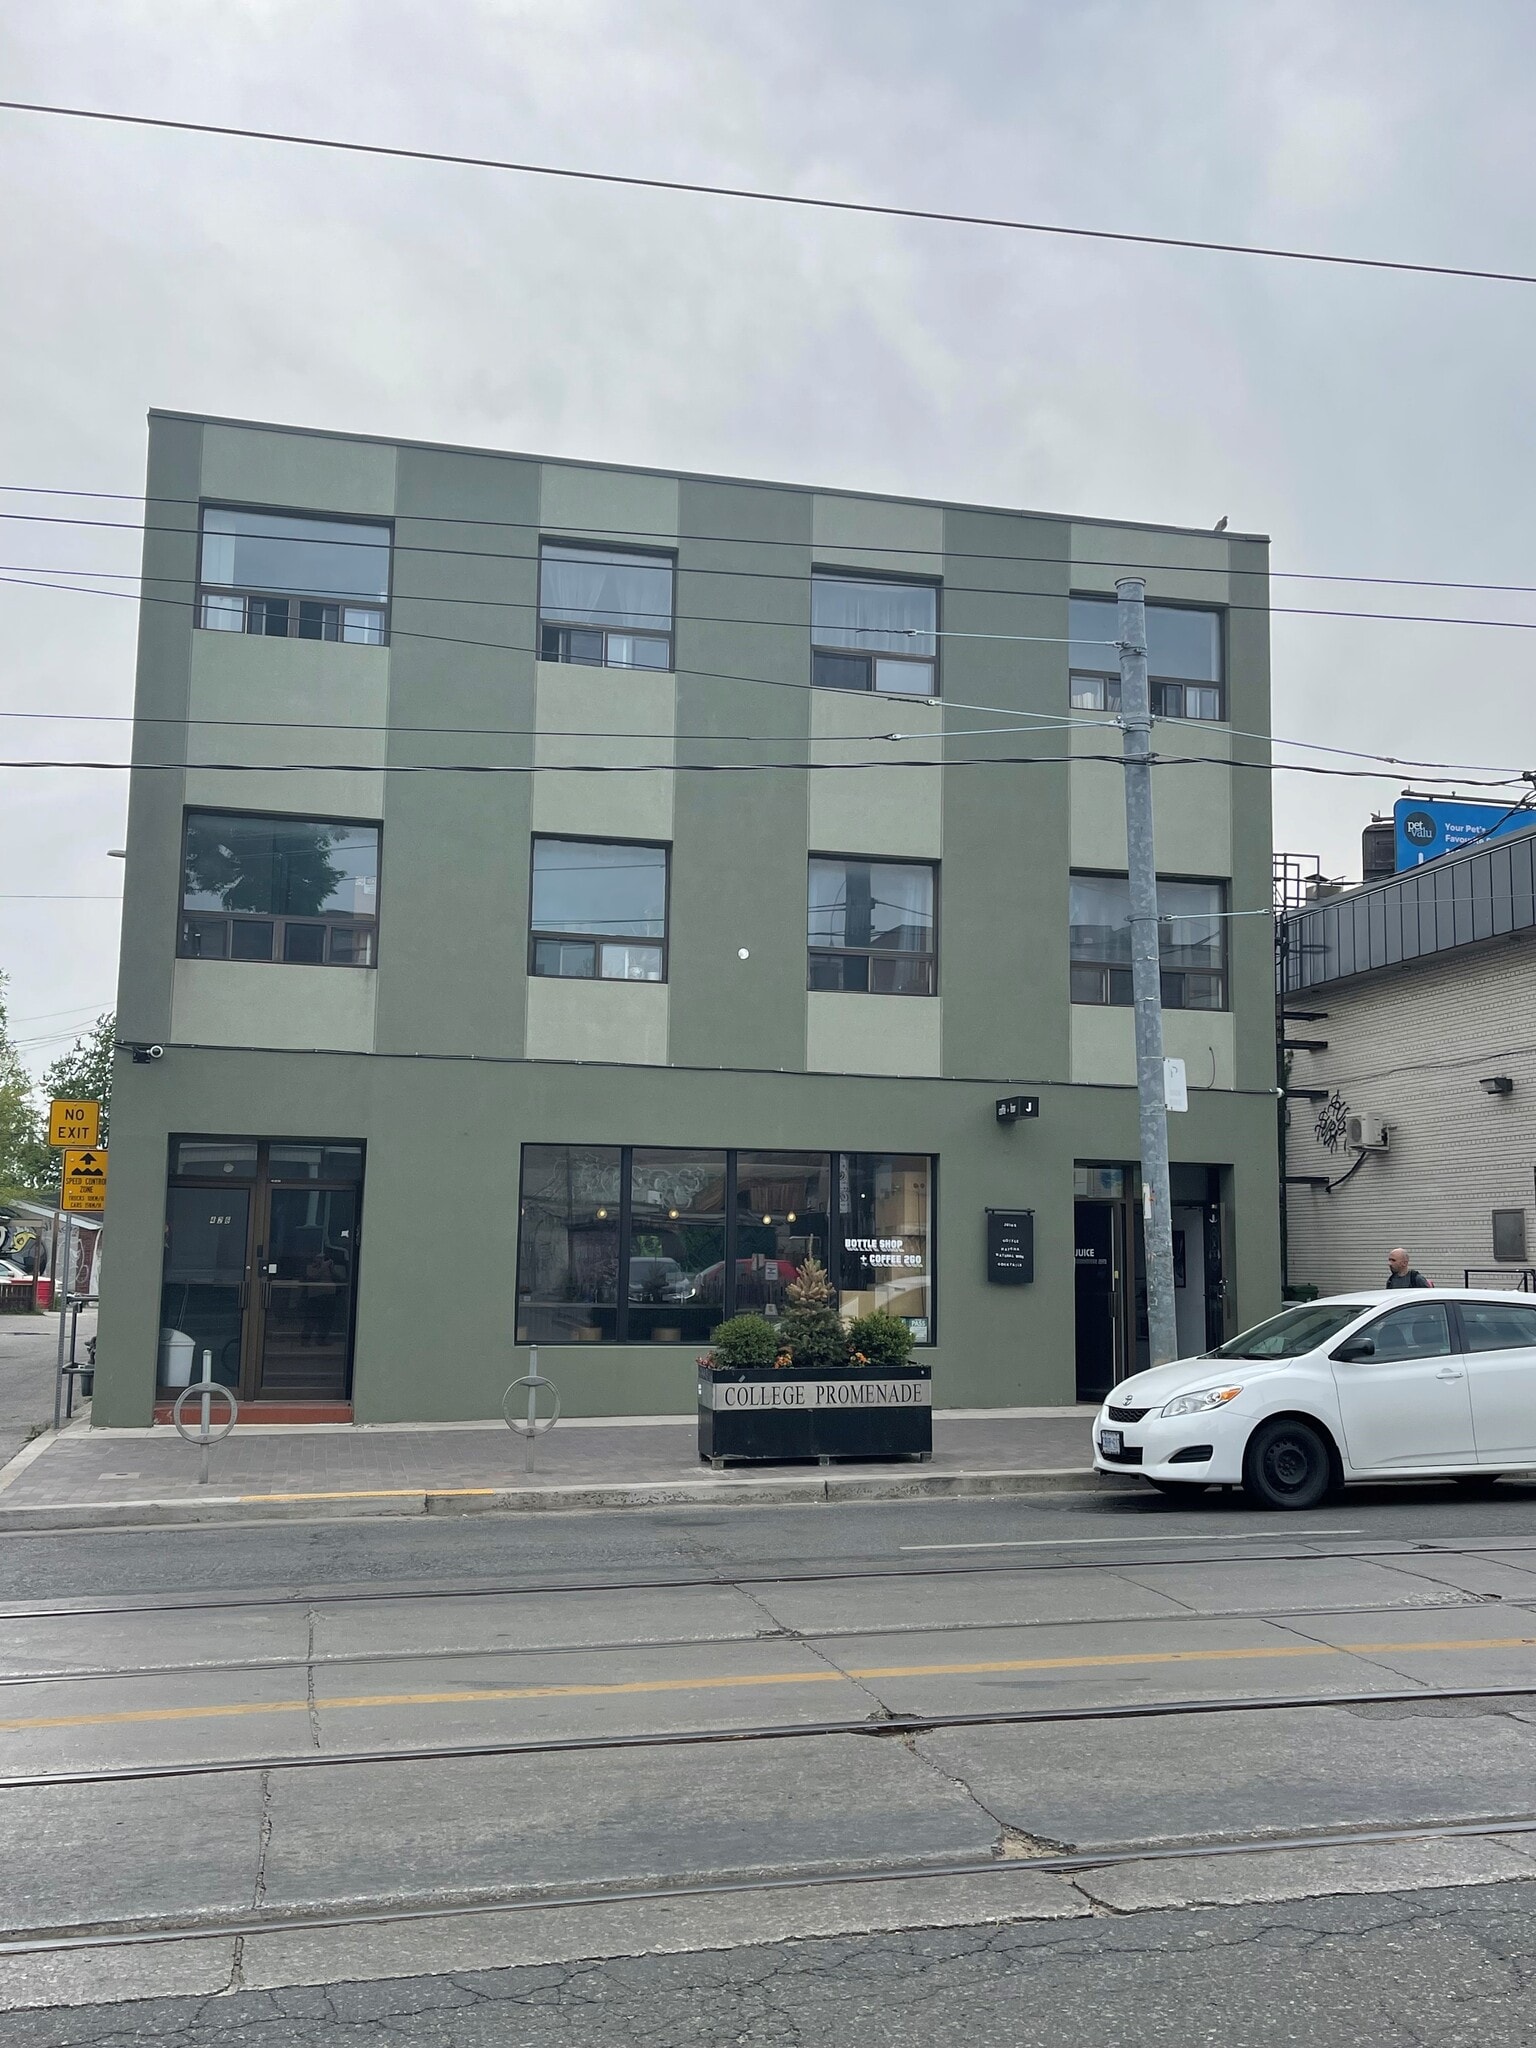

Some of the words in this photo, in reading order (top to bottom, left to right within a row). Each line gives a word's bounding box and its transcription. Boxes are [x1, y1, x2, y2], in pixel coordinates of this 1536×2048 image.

[1407, 821, 1423, 832] pet
[1445, 823, 1464, 832] Your
[1412, 827, 1432, 838] valu
[1445, 834, 1484, 845] Favoute
[1025, 1102, 1032, 1112] J
[65, 1109, 84, 1121] NO
[58, 1127, 89, 1139] EXIT
[85, 1178, 107, 1186] CONTRO
[80, 1186, 93, 1194] ZONE
[844, 1238, 878, 1250] BOTTLE
[879, 1239, 904, 1251] SHOP
[1075, 1248, 1095, 1257] JUICE
[869, 1254, 902, 1266] COFFEE
[725, 1386, 805, 1407] COLLEGE
[816, 1383, 922, 1404] PROMENADE
